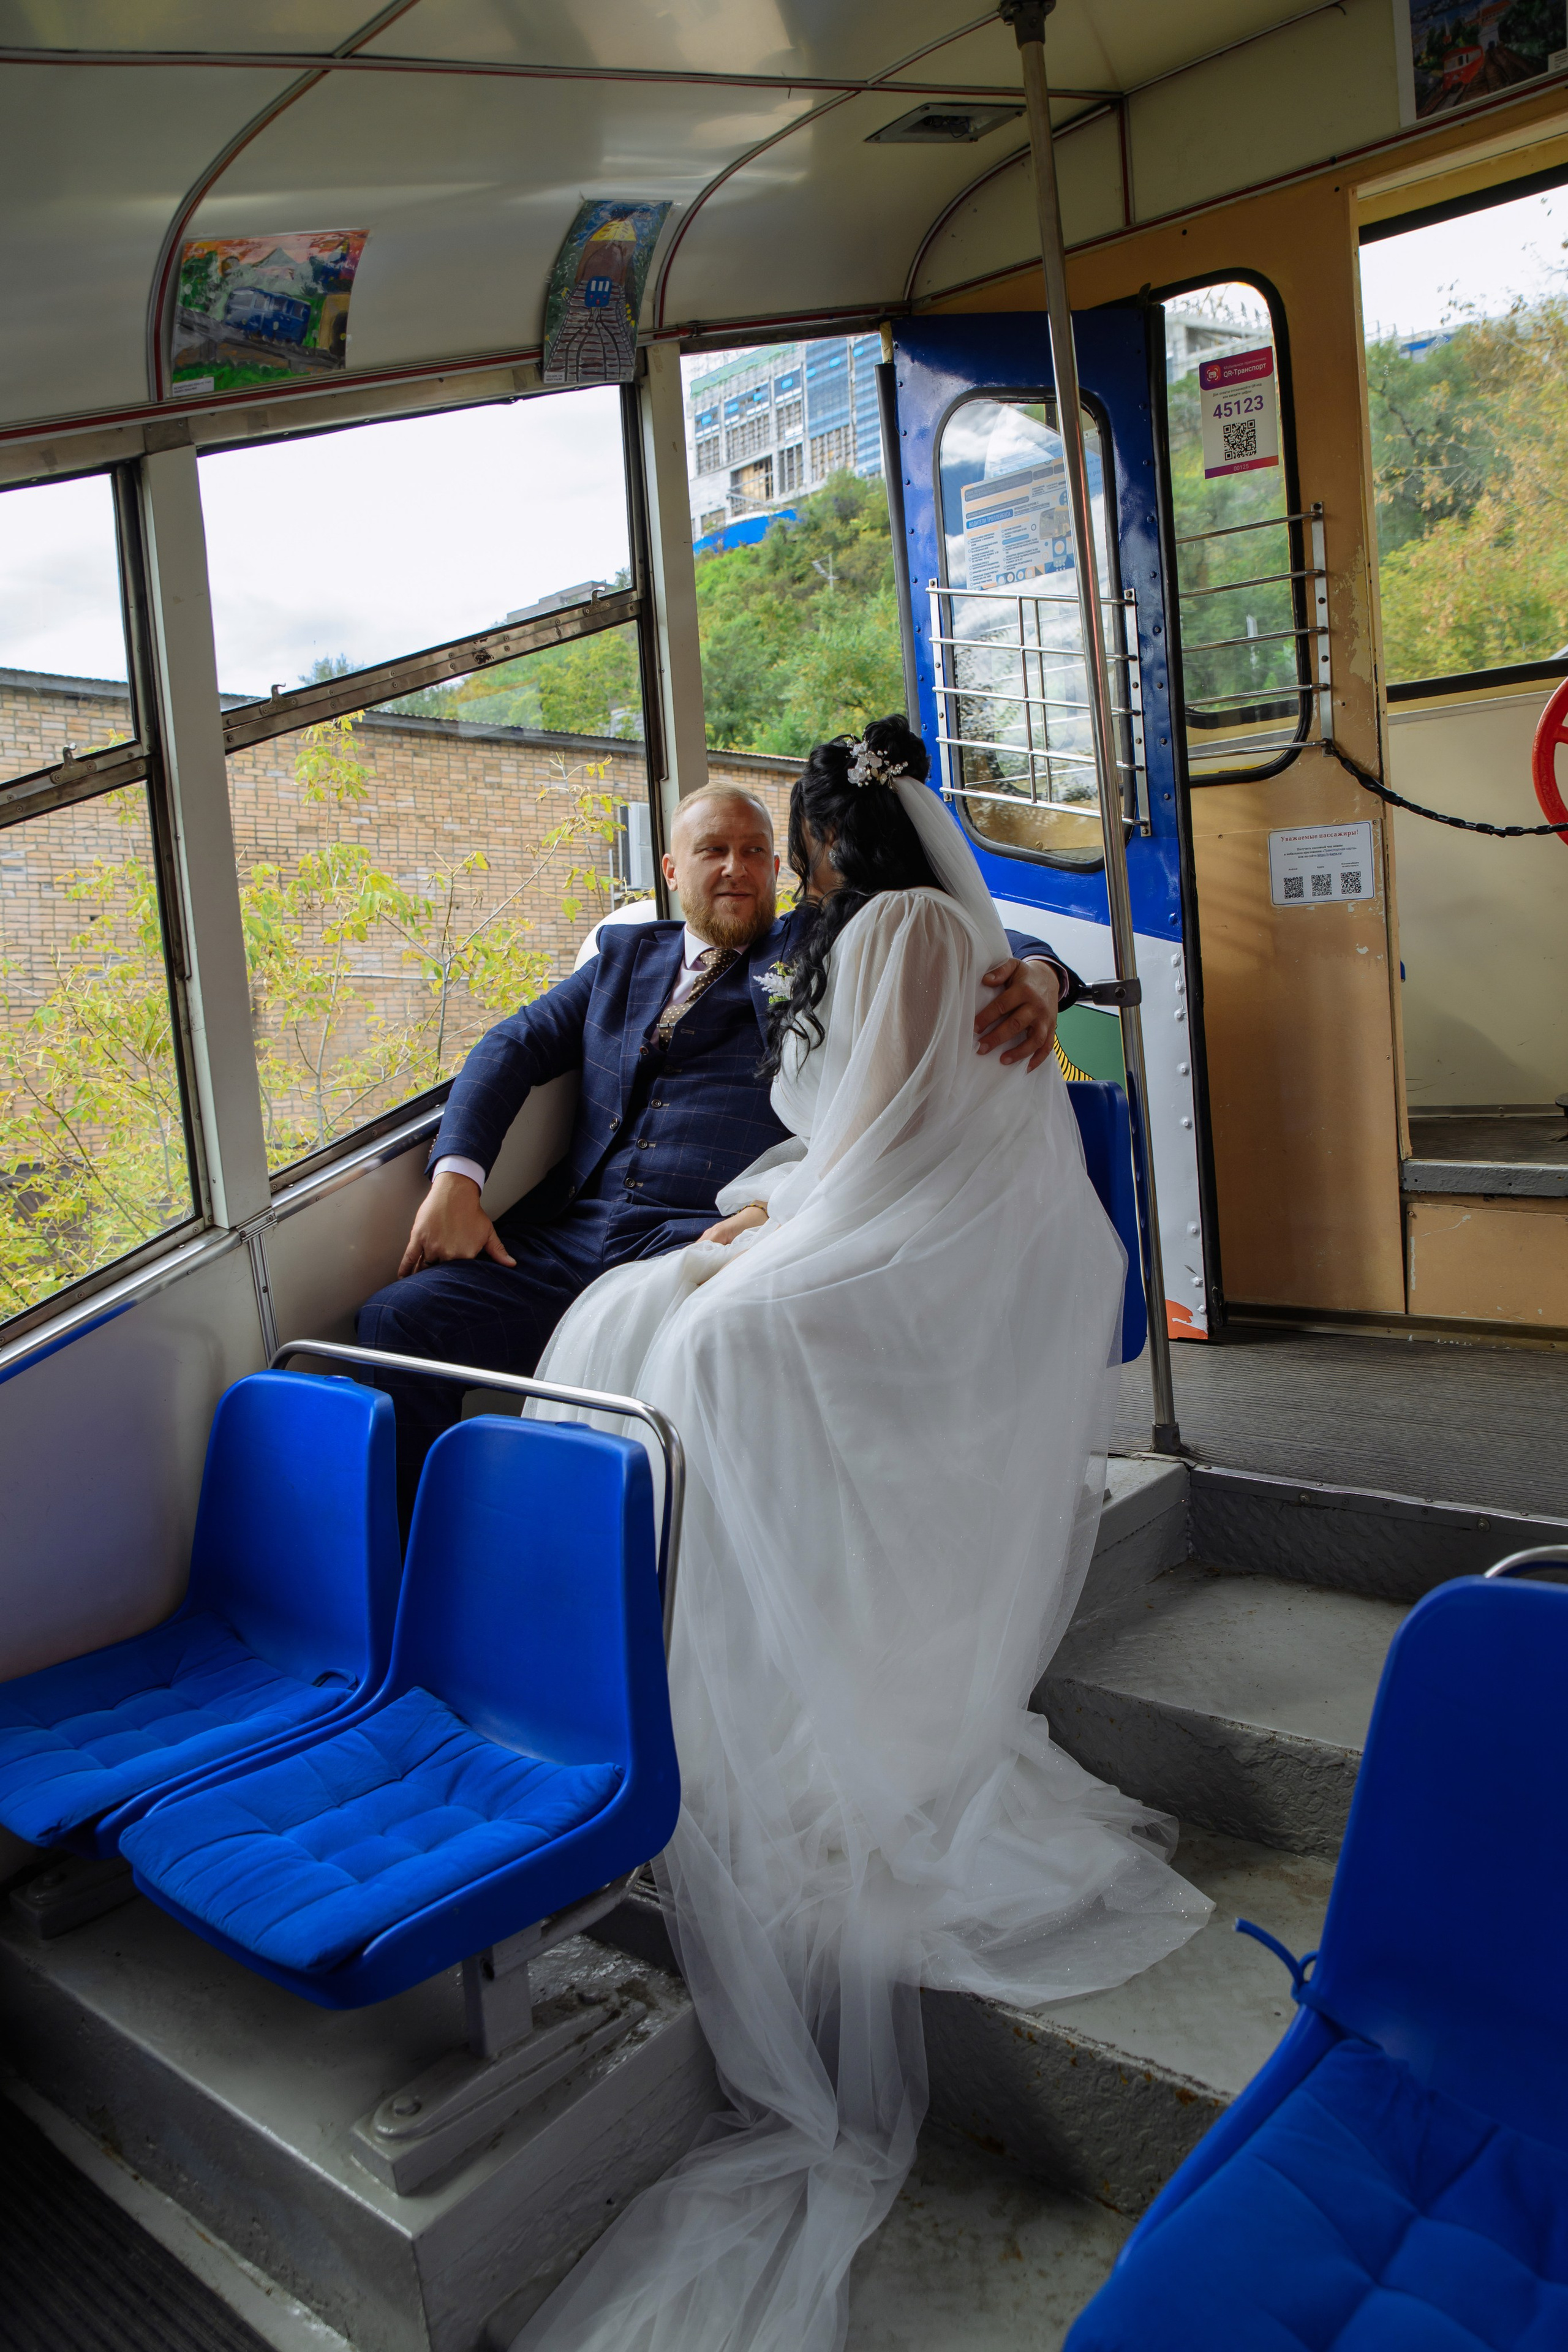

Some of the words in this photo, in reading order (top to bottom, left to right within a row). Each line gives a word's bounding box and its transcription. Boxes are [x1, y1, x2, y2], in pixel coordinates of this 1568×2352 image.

[1223, 363, 1267, 378] QR-Транспорт
[1213, 395, 1264, 419] 45123
[1319, 829, 1359, 839] пассажиры!
